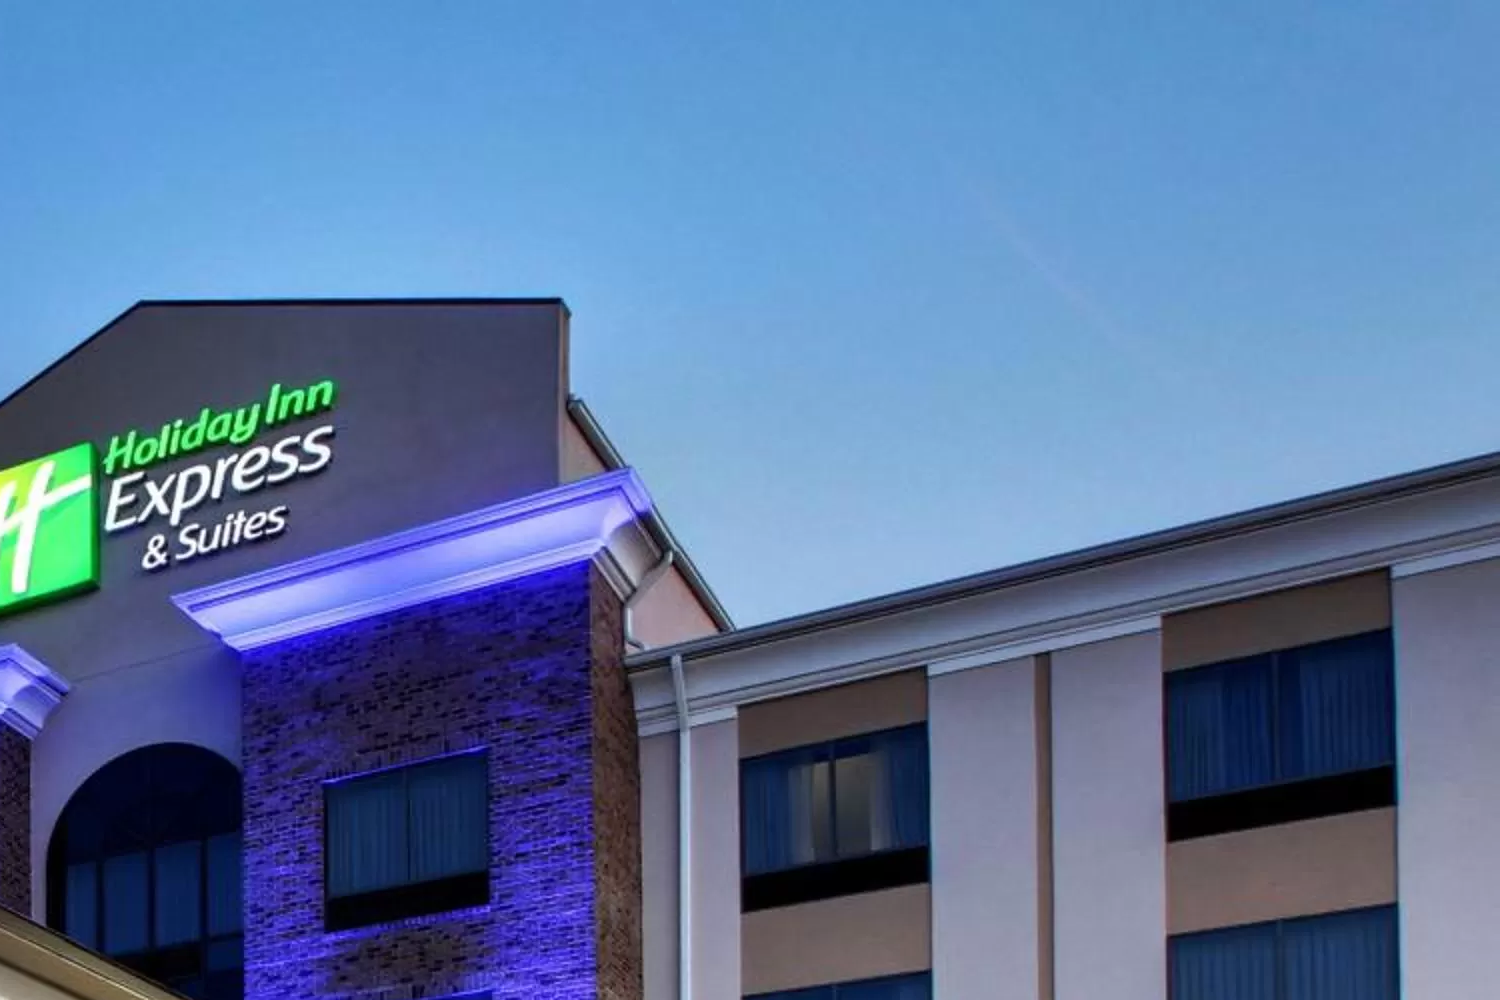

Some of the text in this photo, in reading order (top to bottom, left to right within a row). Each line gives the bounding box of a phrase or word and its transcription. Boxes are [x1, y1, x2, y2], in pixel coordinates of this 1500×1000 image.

[103, 379, 334, 474] Holiday Inn
[105, 425, 333, 531] Express
[141, 504, 287, 569] & Suites
